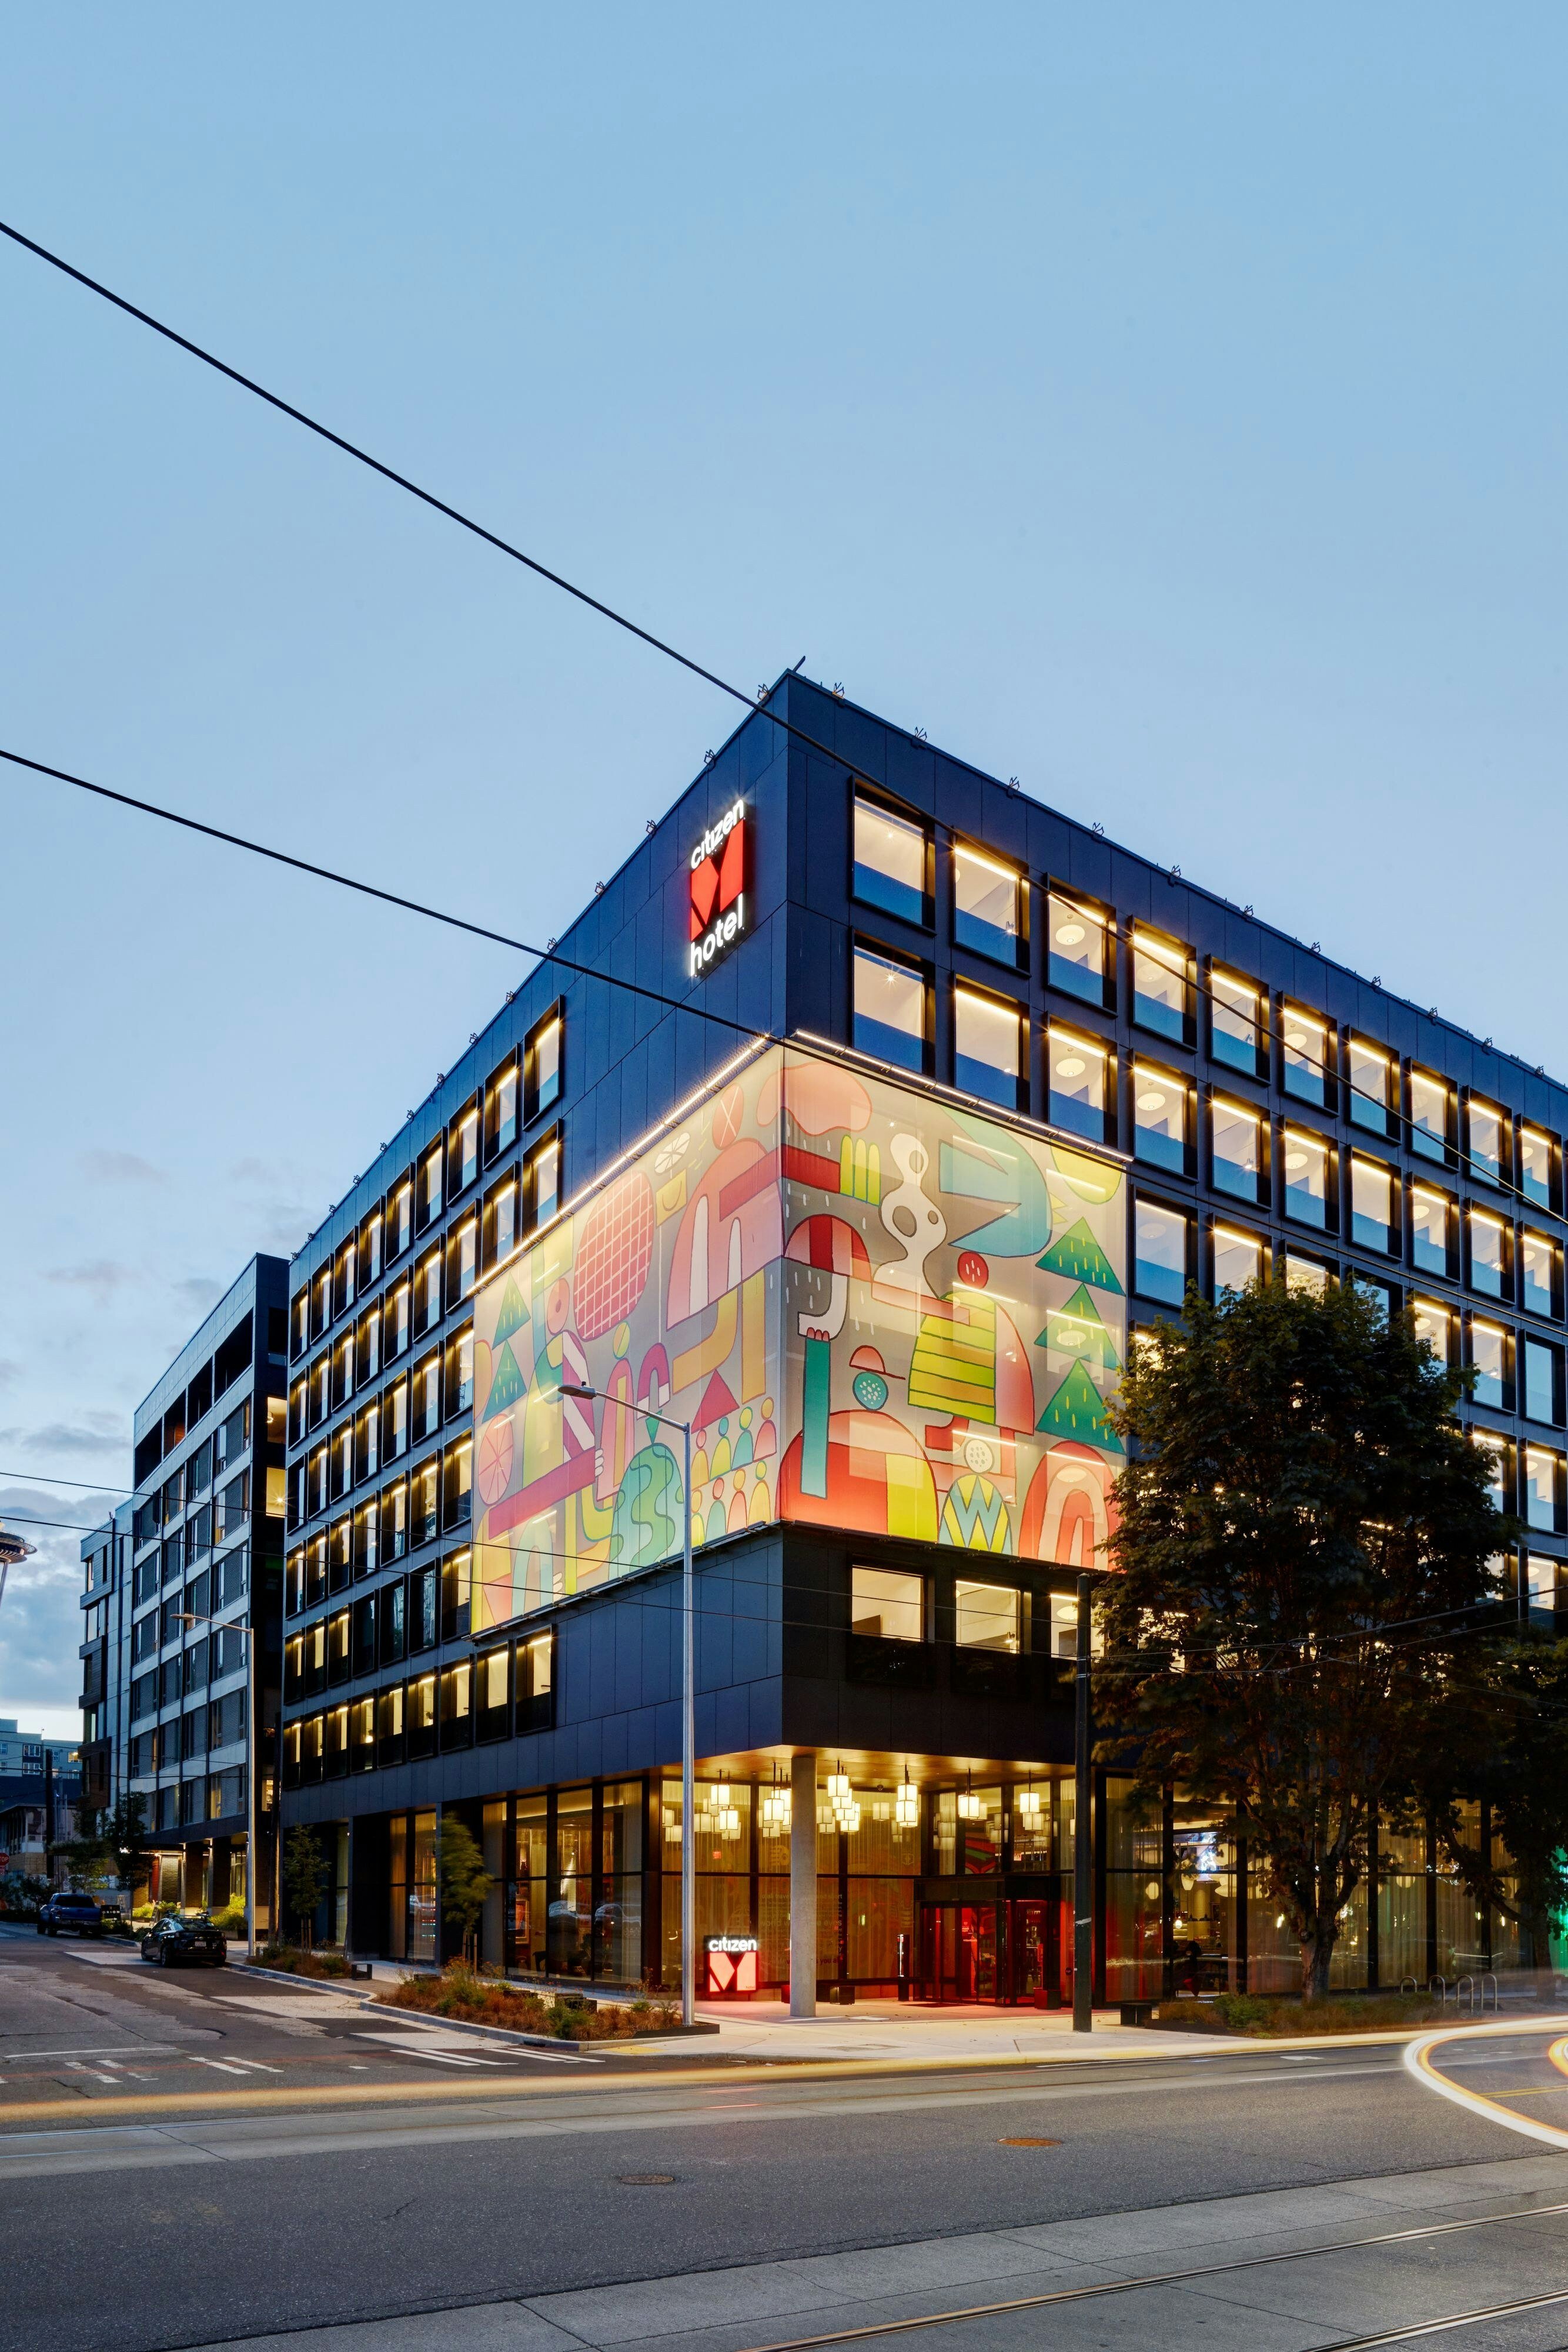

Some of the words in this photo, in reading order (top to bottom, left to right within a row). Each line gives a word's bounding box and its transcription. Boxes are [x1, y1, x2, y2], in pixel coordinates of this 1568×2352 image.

[691, 799, 744, 870] citizen
[690, 893, 743, 976] hotel
[708, 1937, 757, 1952] citizen
[824, 1920, 842, 1928] eyes
